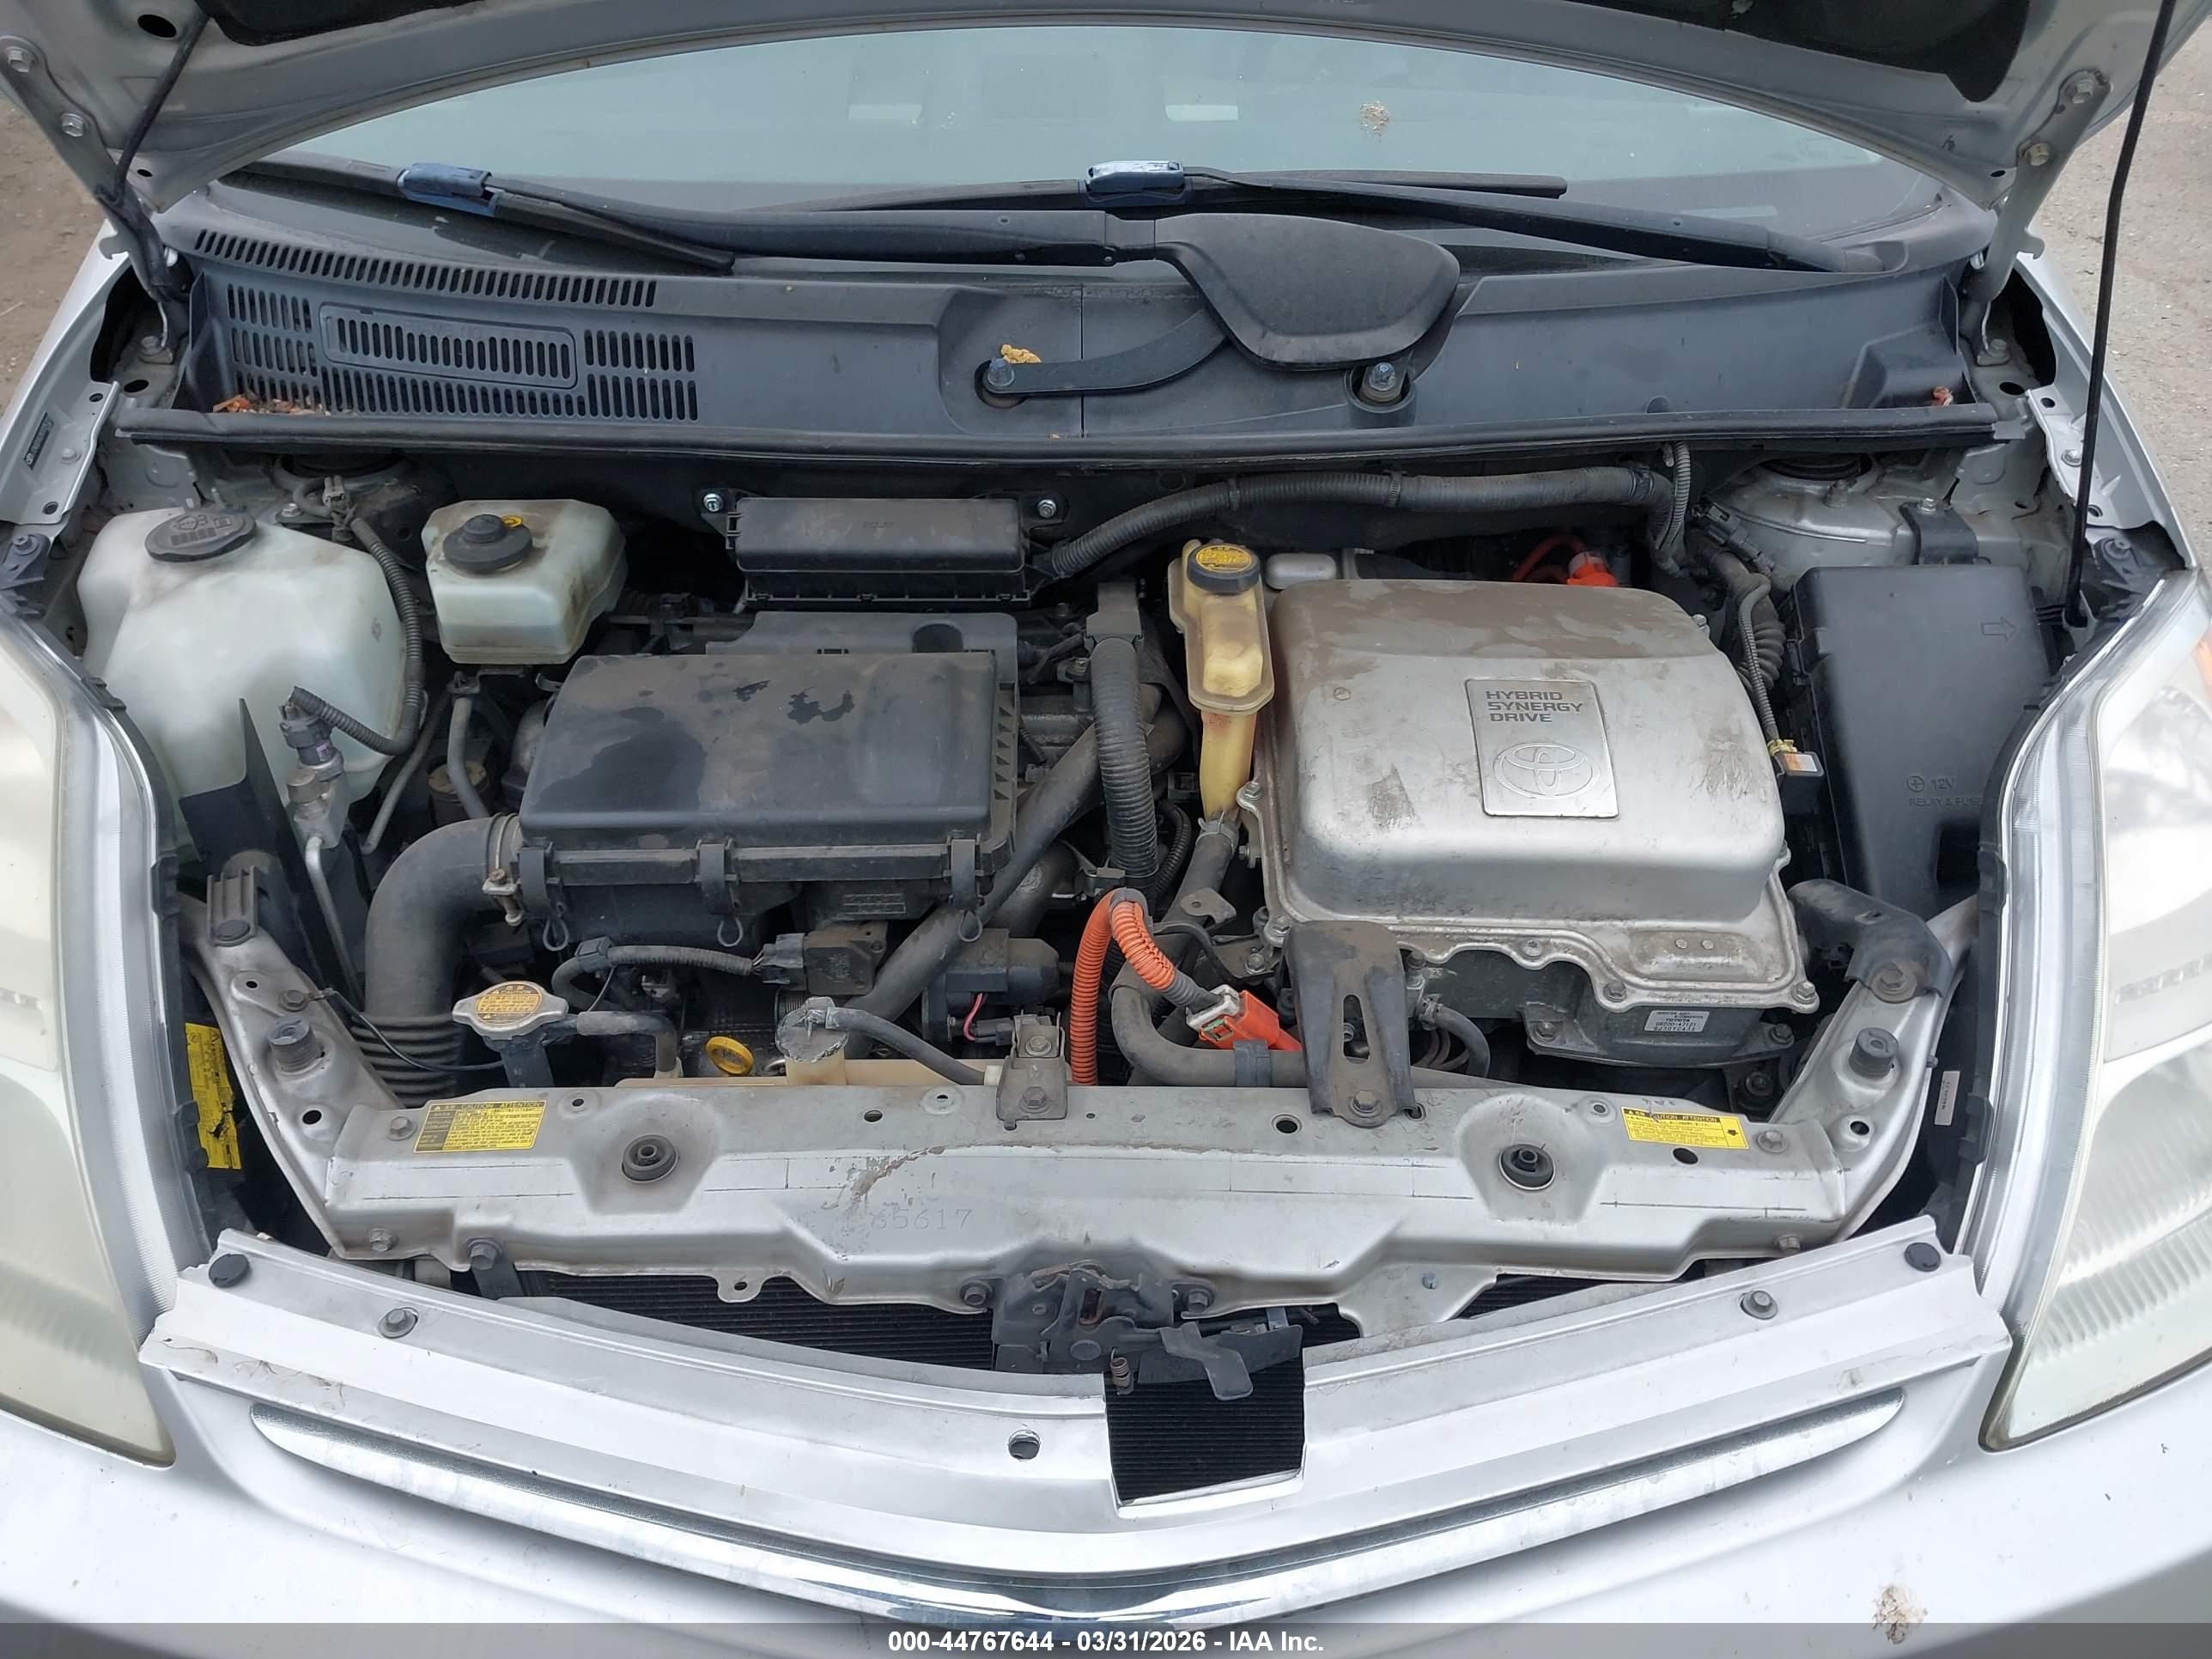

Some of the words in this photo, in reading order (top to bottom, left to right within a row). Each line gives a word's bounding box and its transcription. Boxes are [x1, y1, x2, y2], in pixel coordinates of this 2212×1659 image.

[1486, 691, 1563, 701] HYBRID
[1488, 702, 1583, 712] SYNERGY
[1490, 713, 1553, 722] DRIVE
[1929, 777, 1955, 791] 12V
[1909, 797, 1942, 807] RELAY
